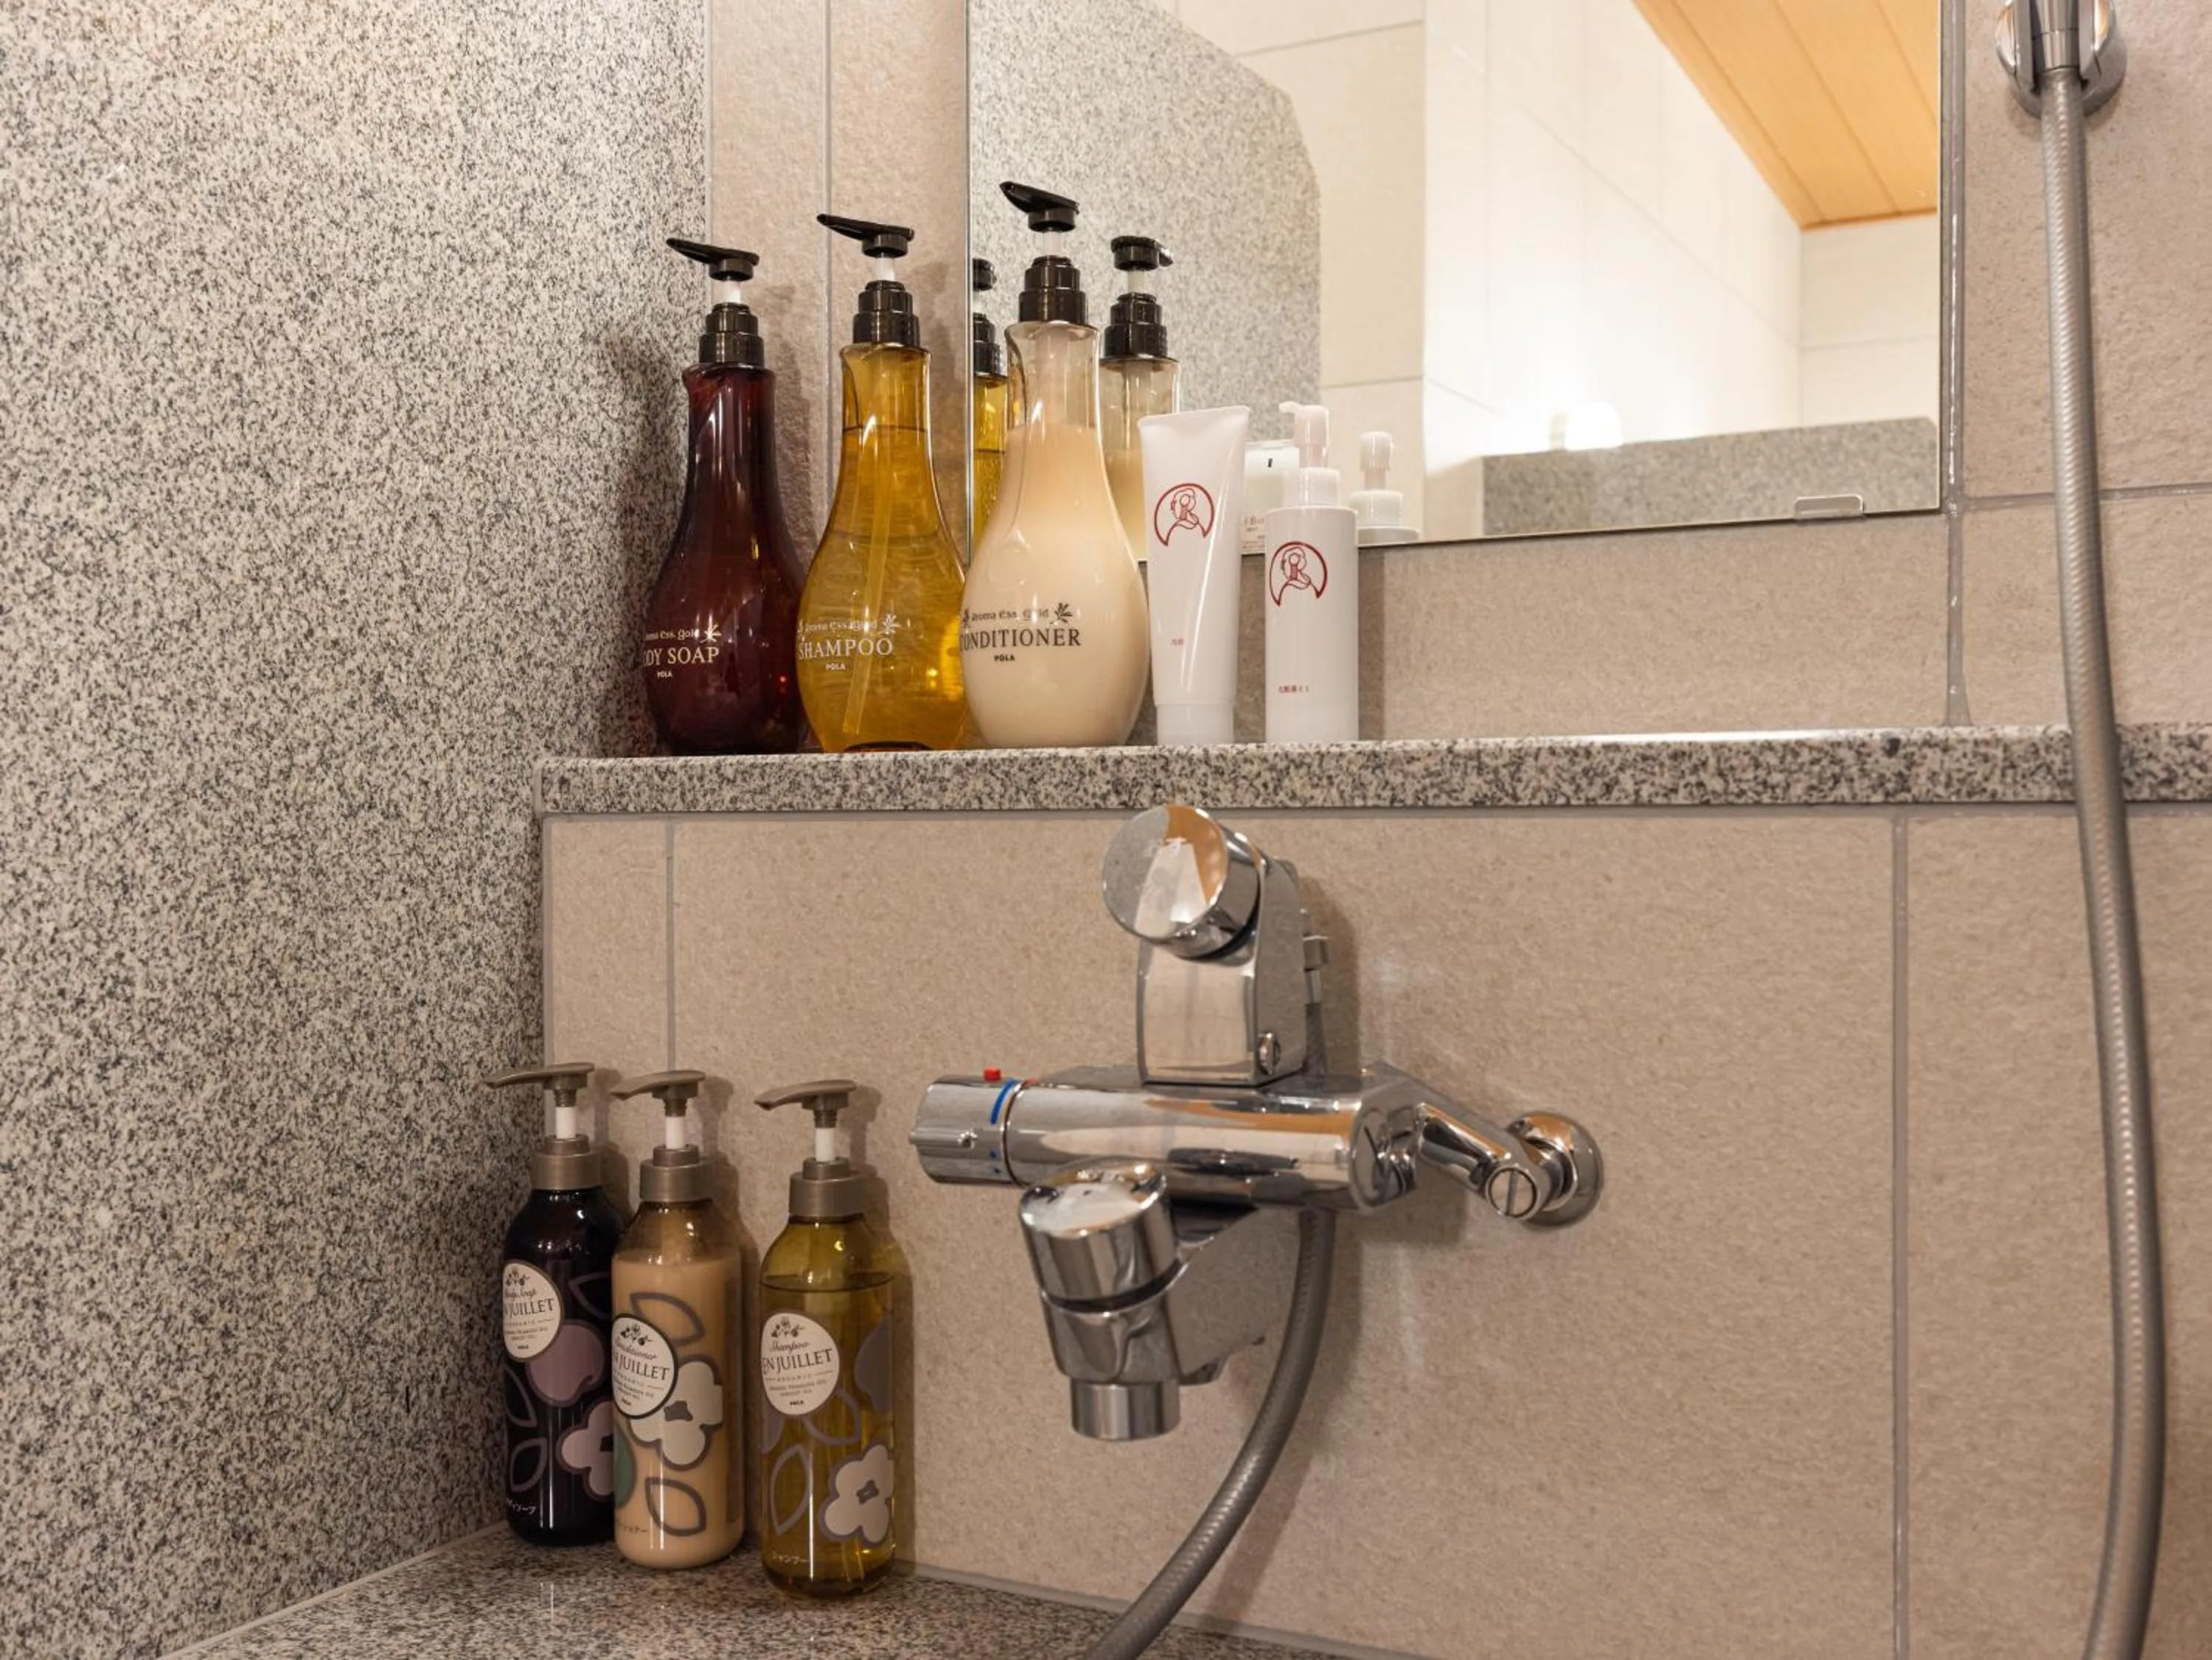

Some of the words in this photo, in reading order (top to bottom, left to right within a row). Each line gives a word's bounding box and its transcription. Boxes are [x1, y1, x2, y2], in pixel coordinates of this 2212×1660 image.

[667, 646, 719, 664] SOAP
[799, 637, 893, 660] SHAMPOO
[993, 654, 1015, 662] POLA
